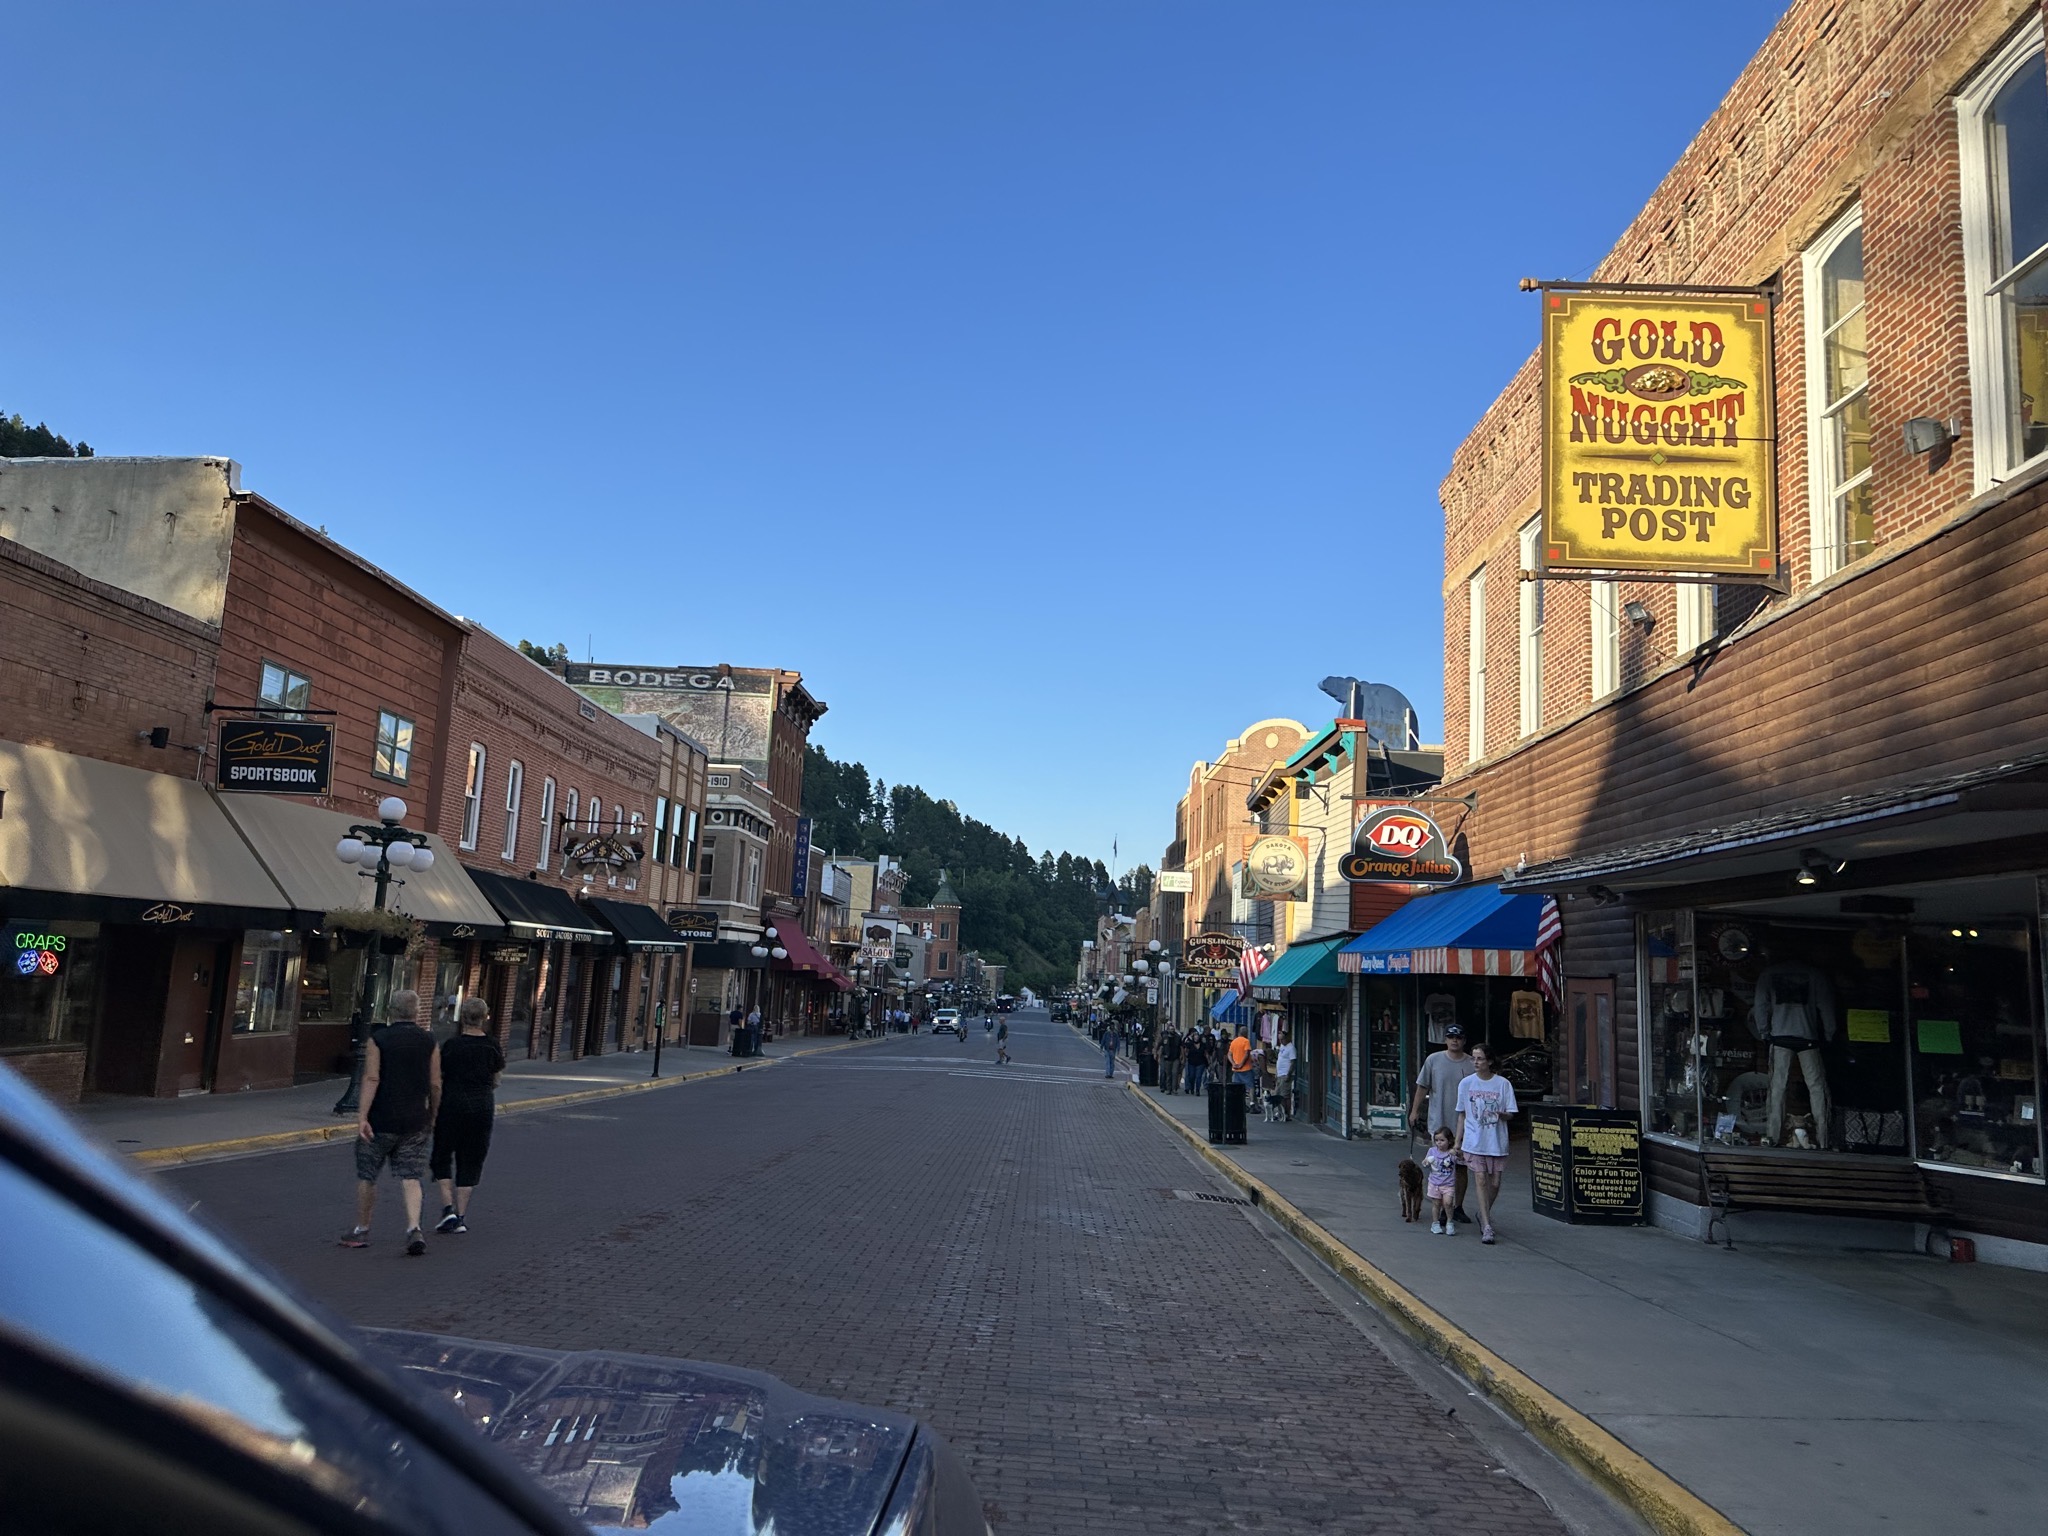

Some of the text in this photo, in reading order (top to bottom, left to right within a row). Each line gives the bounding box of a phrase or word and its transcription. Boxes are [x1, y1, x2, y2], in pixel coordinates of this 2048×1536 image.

[1591, 318, 1725, 367] GOLD
[1570, 385, 1744, 447] NUGGET
[1573, 472, 1751, 509] TRADING
[1602, 508, 1715, 543] POST
[589, 669, 736, 690] BODEGA
[225, 730, 326, 756] Gold Dust
[230, 766, 317, 783] SPORTSBOOK
[1378, 825, 1422, 849] DQ
[1266, 843, 1291, 851] DAKOTA
[796, 823, 808, 890] BODEGA
[1350, 858, 1452, 877] Orange Julius
[142, 903, 194, 923] Gold Dust
[16, 933, 66, 951] CRAPS
[536, 929, 553, 939] SCOTT
[555, 931, 573, 941] JACOBS
[1189, 937, 1243, 948] GUNSLINGER
[862, 948, 893, 957] SALOON
[1195, 957, 1236, 966] SALOON
[1575, 1168, 1597, 1176] Enjoy
[1604, 1169, 1618, 1177] Fun
[1620, 1169, 1638, 1178] Tour
[1584, 1190, 1632, 1199] Mount Moriah
[1587, 1184, 1623, 1192] Deadwood
[1591, 1197, 1625, 1205] Cemetery
